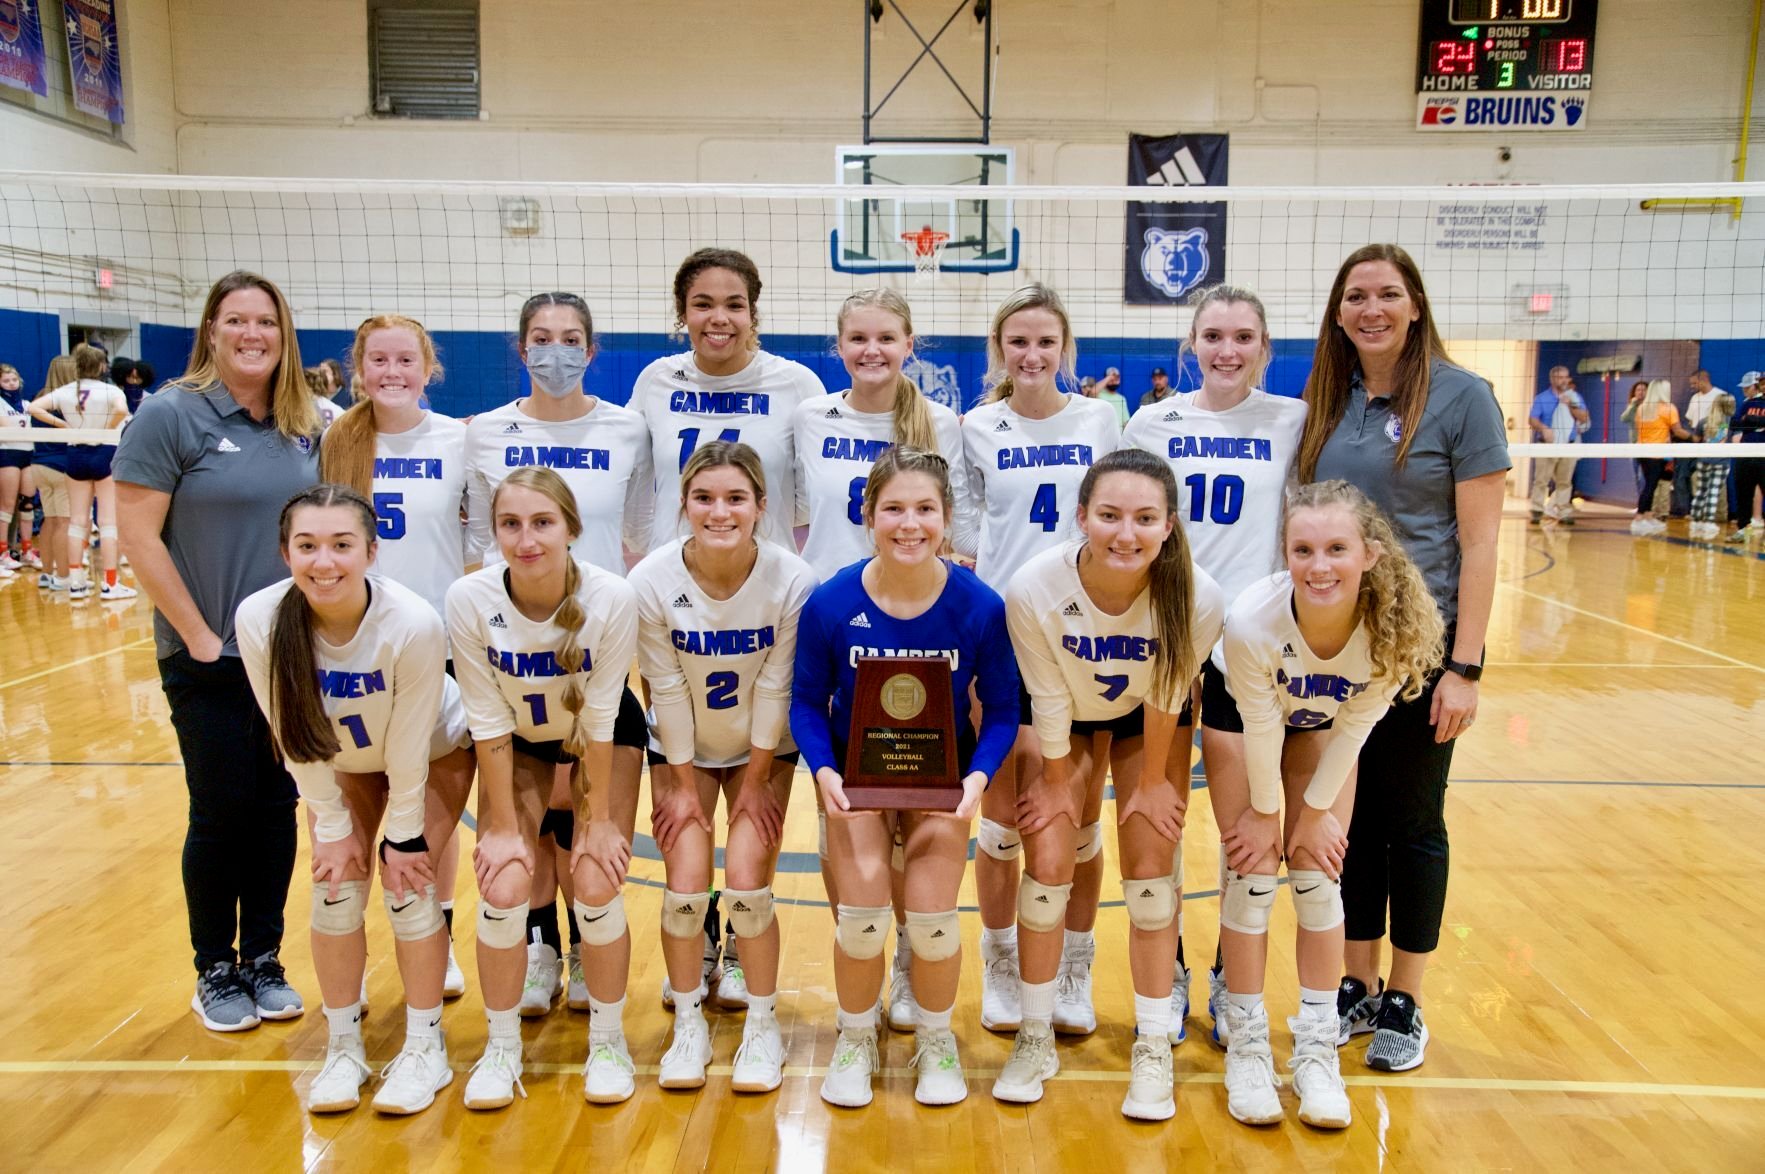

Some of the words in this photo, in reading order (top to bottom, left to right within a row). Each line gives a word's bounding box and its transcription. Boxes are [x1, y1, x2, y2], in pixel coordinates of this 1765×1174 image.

[1487, 26, 1530, 38] BONUS
[1438, 42, 1475, 72] 24
[1487, 50, 1527, 61] PERIOD
[1558, 40, 1584, 71] 13
[1423, 75, 1479, 90] HOME
[1497, 62, 1514, 87] 3
[1528, 74, 1591, 89] VISITOR
[1427, 97, 1460, 105] PEPSI
[1465, 96, 1556, 125] BRUINS
[670, 390, 770, 416] CAMDEN
[505, 446, 610, 471] CAMDEN
[997, 443, 1093, 471] CAMDEN
[1168, 435, 1272, 461] CAMDEN
[373, 458, 442, 480] MDEN
[1029, 483, 1059, 532] 4
[1185, 473, 1245, 525] 10
[373, 492, 406, 540] 5
[488, 621, 507, 629] adidas
[849, 620, 872, 629] adidas
[671, 626, 775, 656] CAMDEN
[487, 646, 593, 678] CAMDN
[317, 669, 386, 698] MDEN
[706, 670, 739, 710] 2
[1094, 673, 1129, 702] 7
[522, 693, 549, 726] 1
[903, 732, 939, 740] CHAMPION
